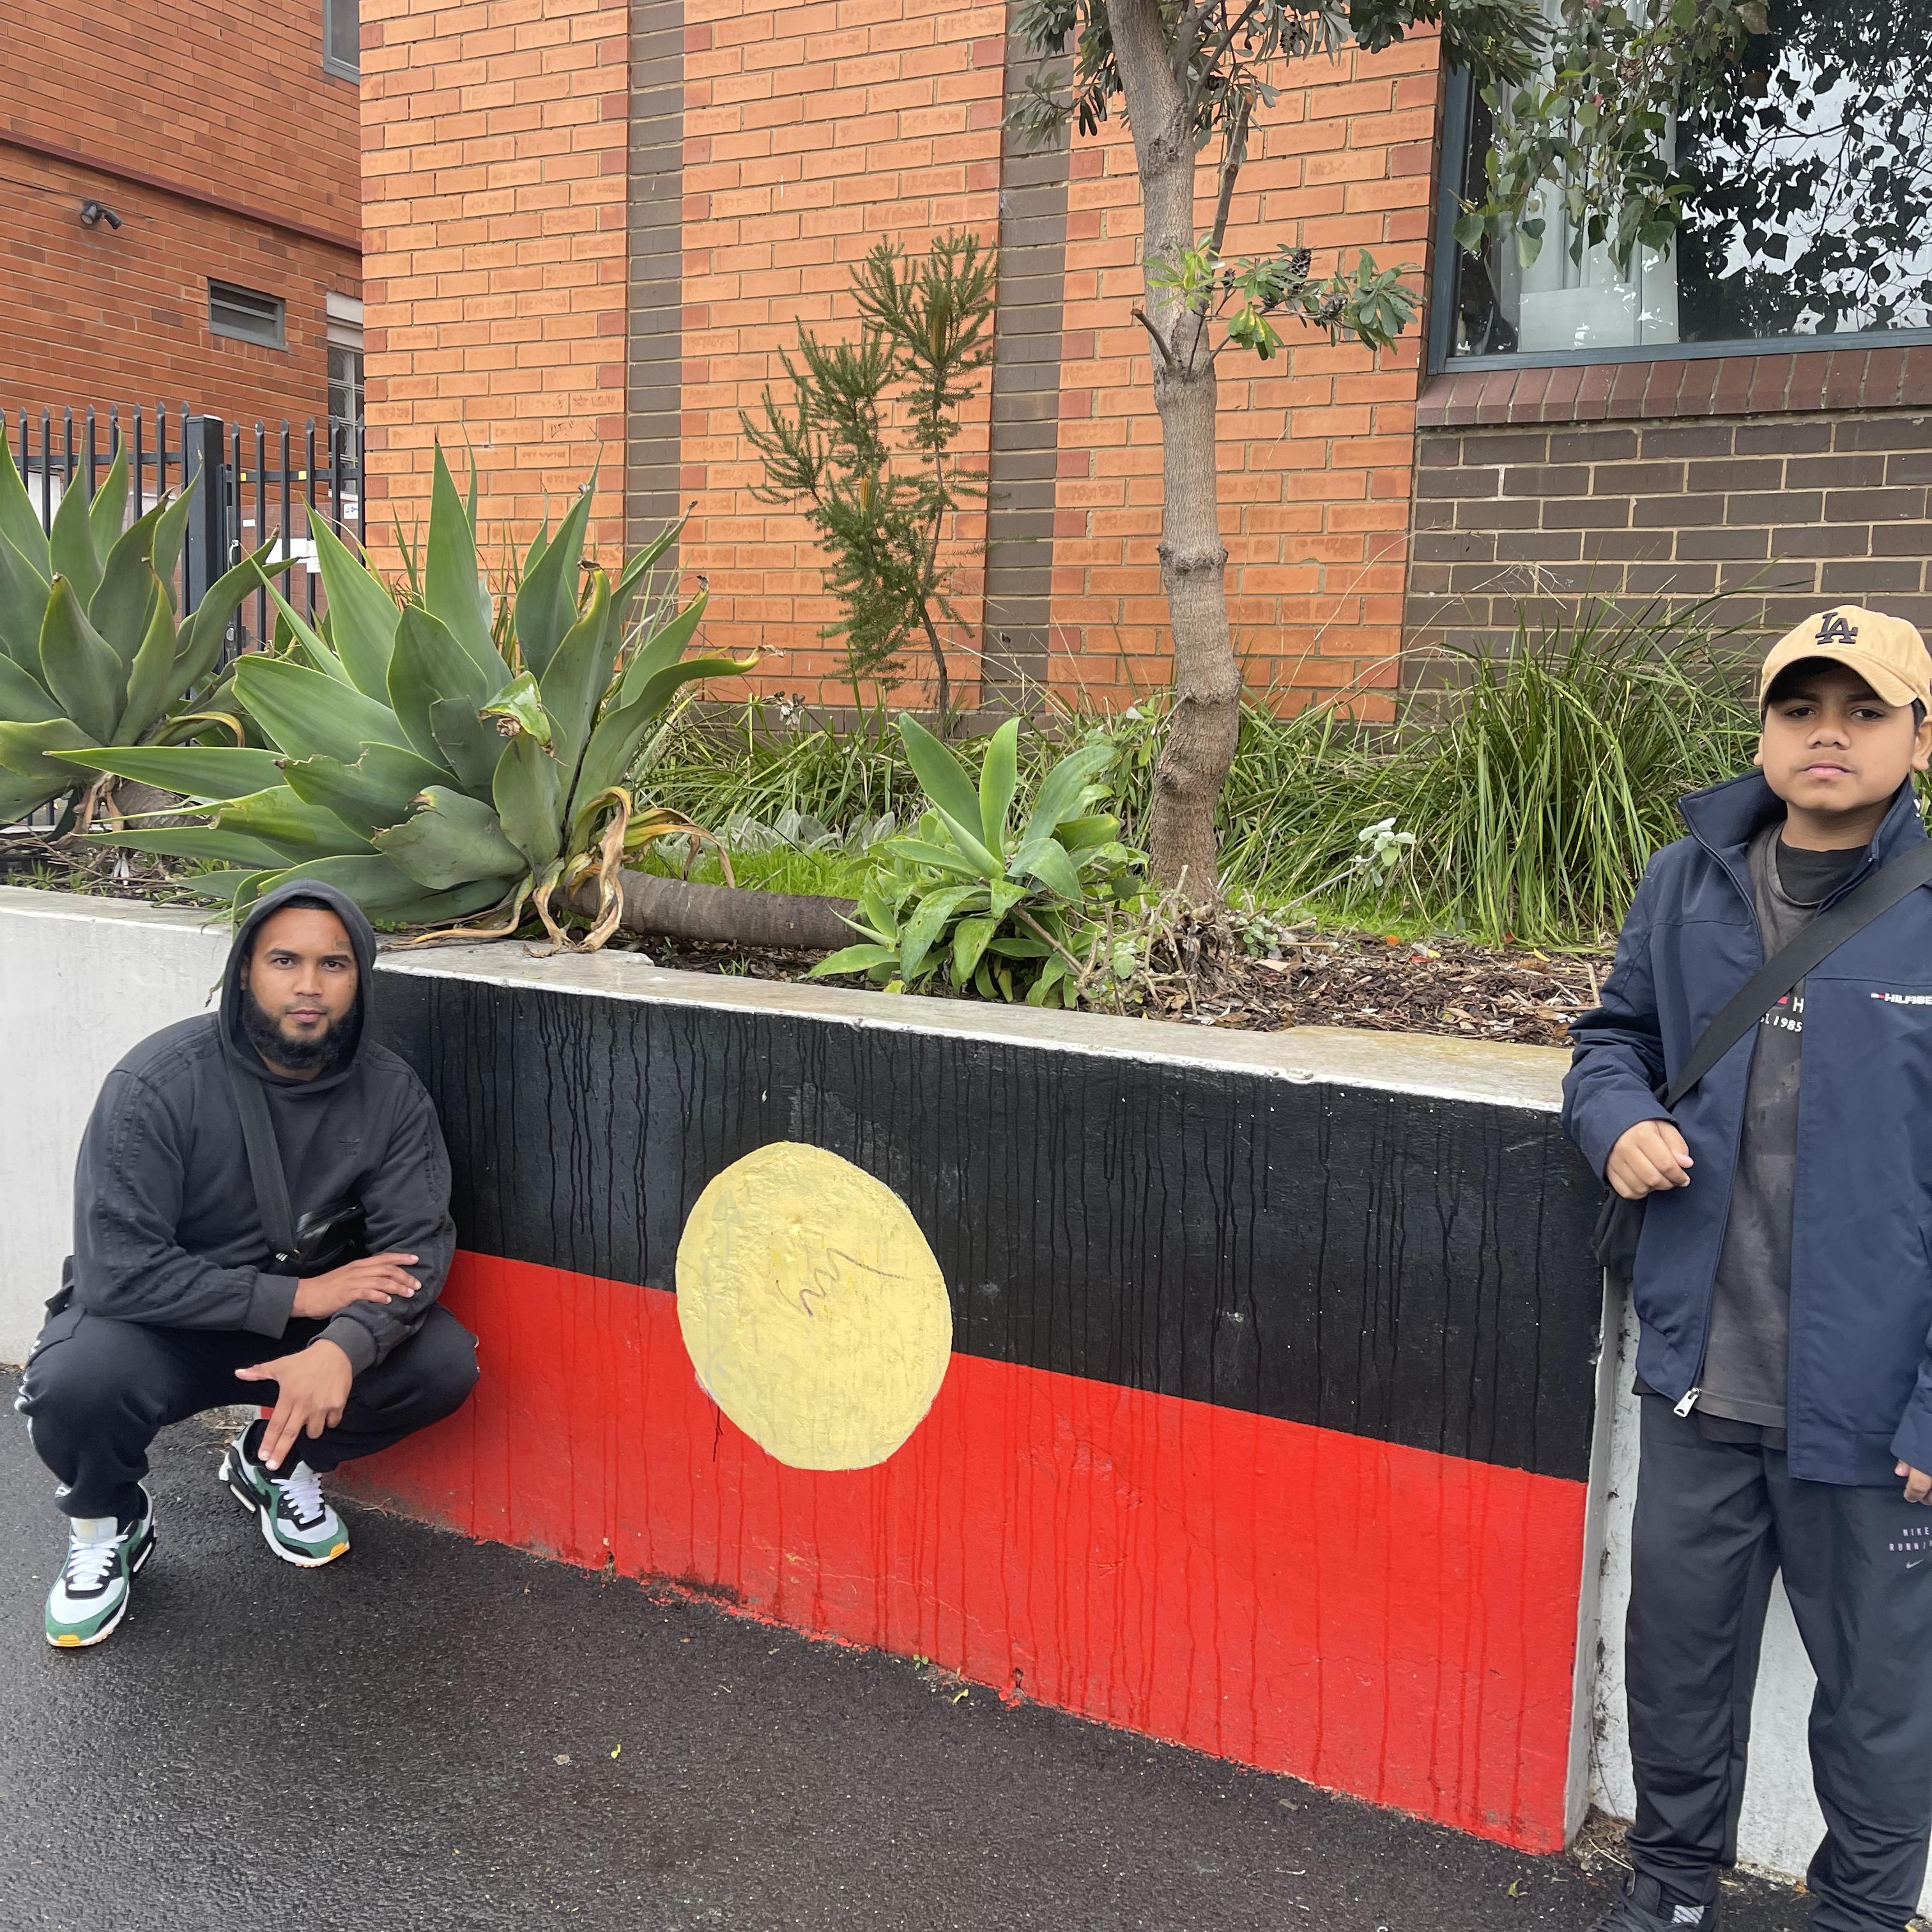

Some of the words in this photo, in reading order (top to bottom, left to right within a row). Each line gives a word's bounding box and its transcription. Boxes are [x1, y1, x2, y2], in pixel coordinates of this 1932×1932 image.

[1815, 611, 1859, 645] LA
[1773, 1016, 1803, 1032] 1985
[1903, 1526, 1930, 1537] NIKE
